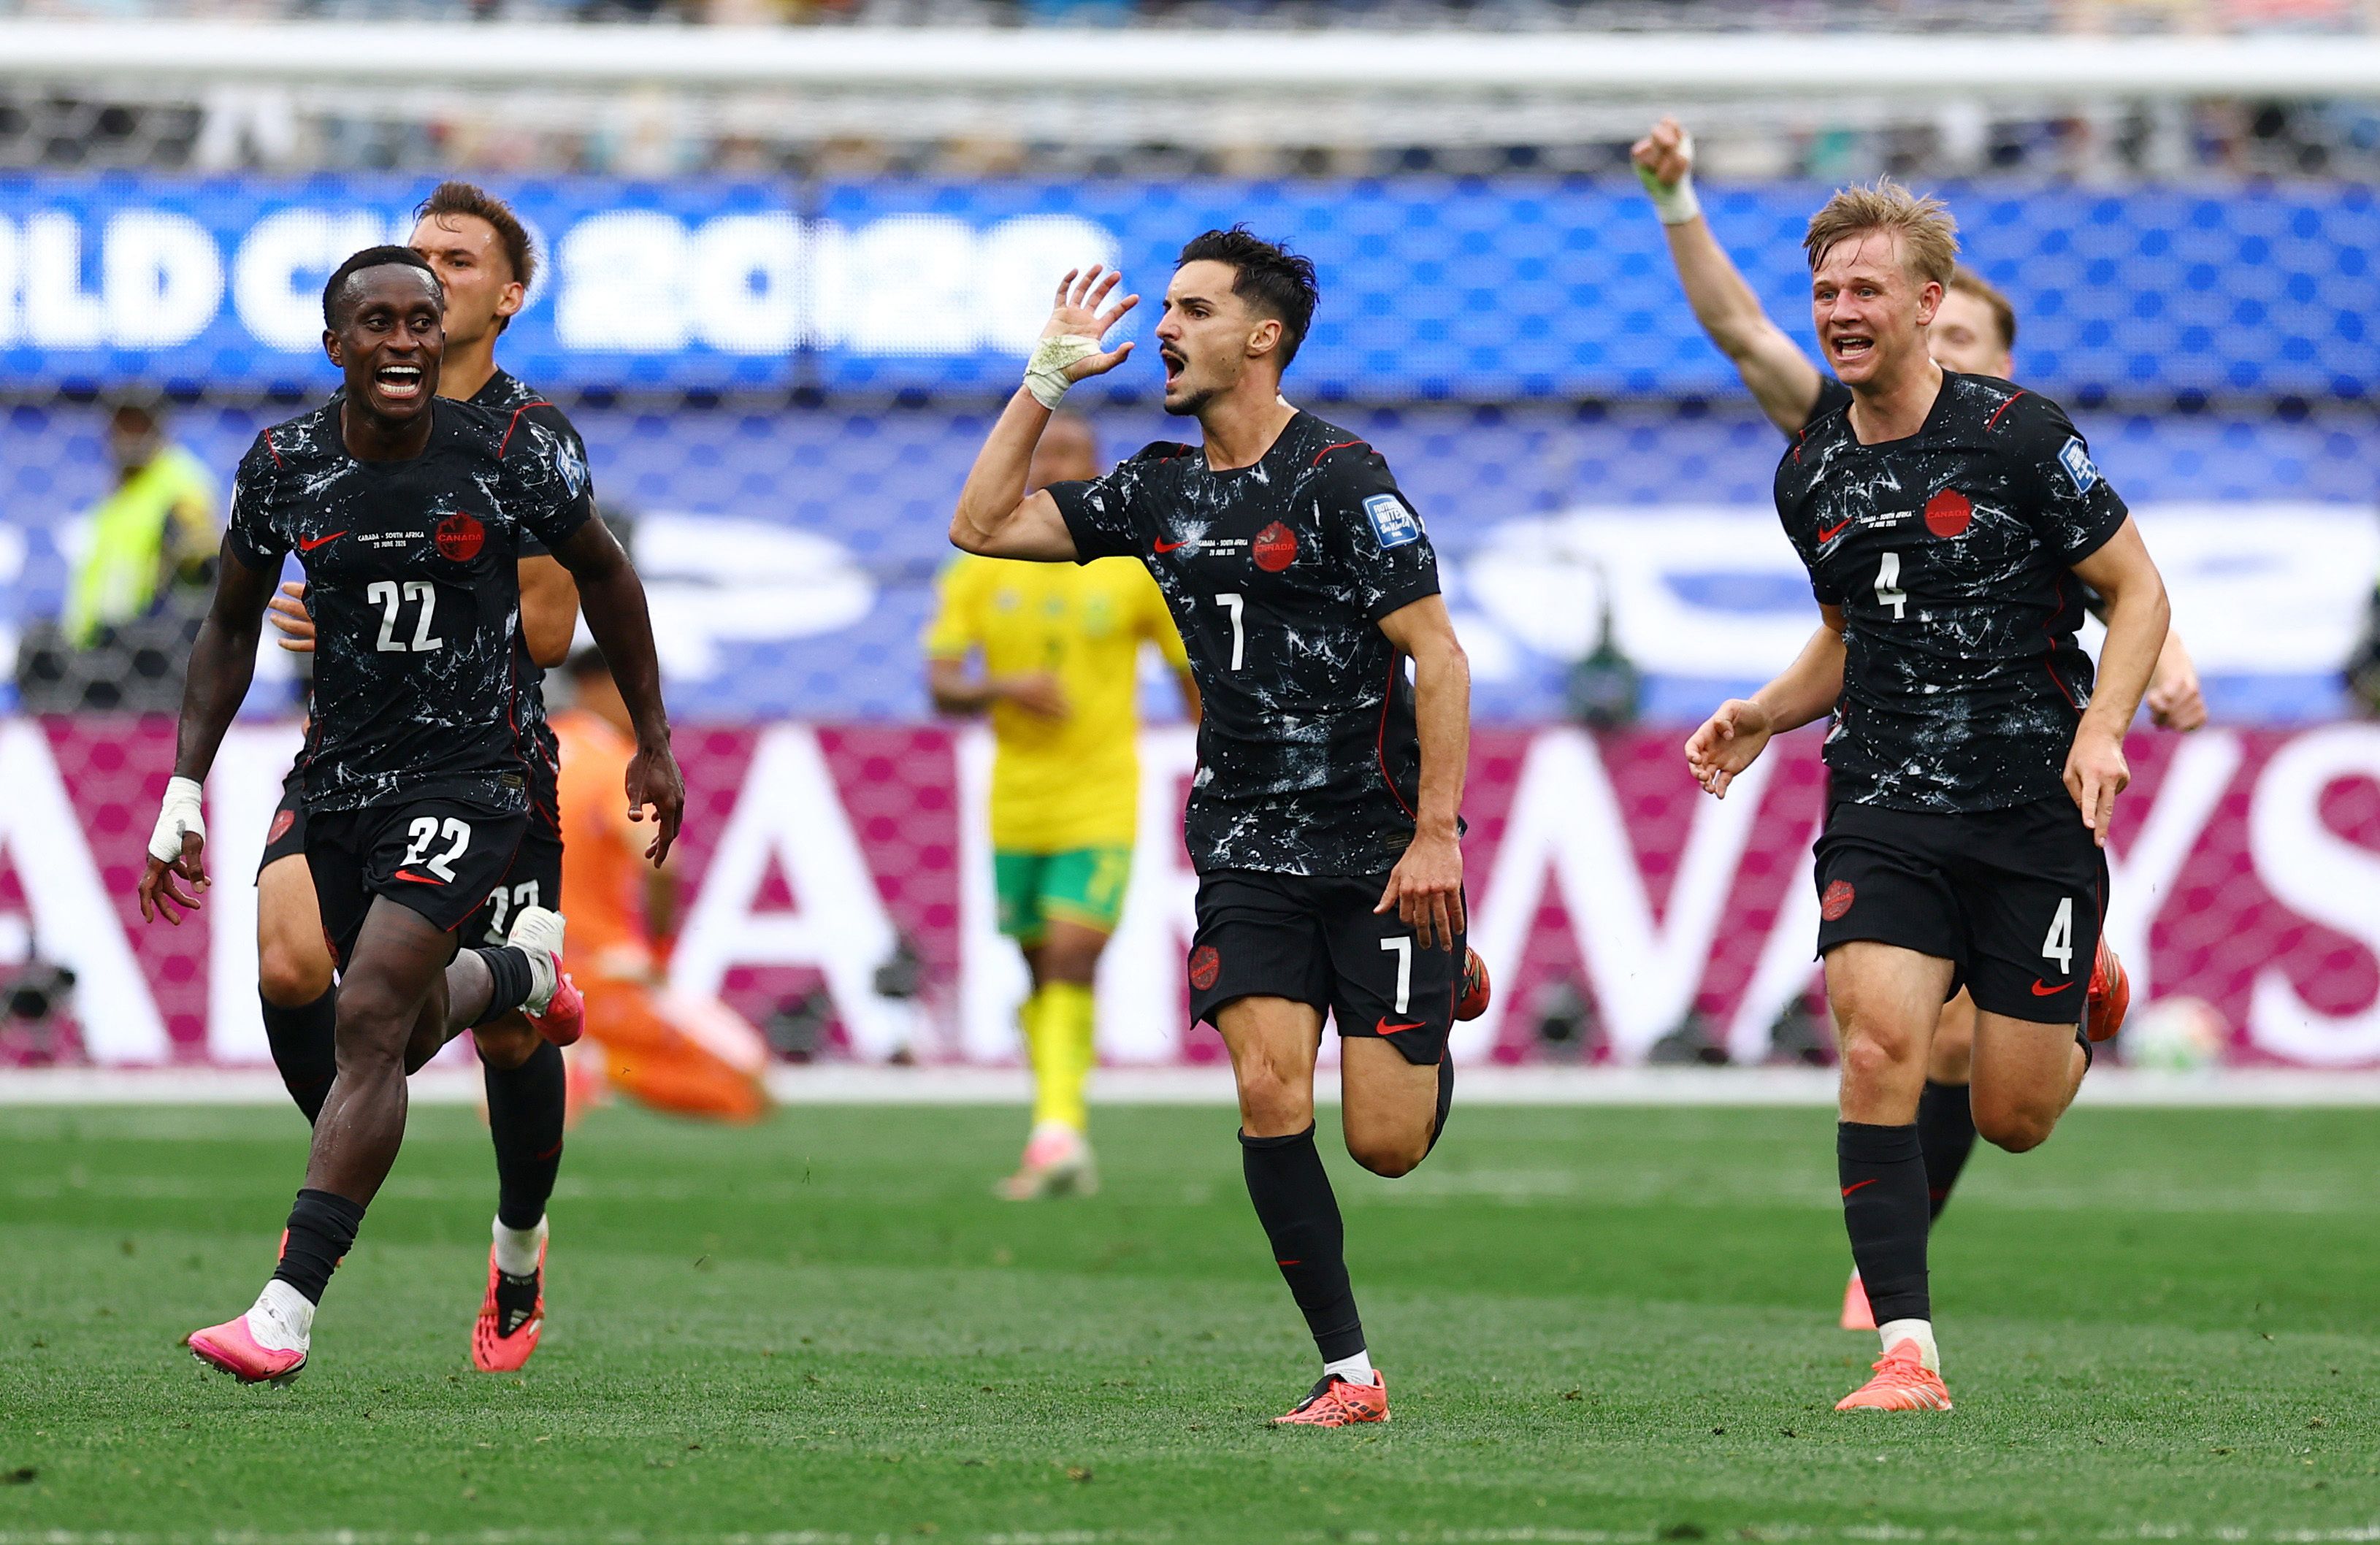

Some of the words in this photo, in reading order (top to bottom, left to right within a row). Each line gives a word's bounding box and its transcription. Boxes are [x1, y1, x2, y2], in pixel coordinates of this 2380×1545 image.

[0, 209, 224, 352] LD
[358, 533, 379, 542] CANADA
[438, 534, 481, 542] CANADA
[1927, 510, 1968, 518] CANADA
[367, 580, 443, 652] 22
[1875, 552, 1907, 619] 4
[1214, 593, 1244, 671] 7
[399, 816, 471, 883] 22
[2042, 898, 2073, 975] 4
[1380, 937, 1412, 1014] 7
